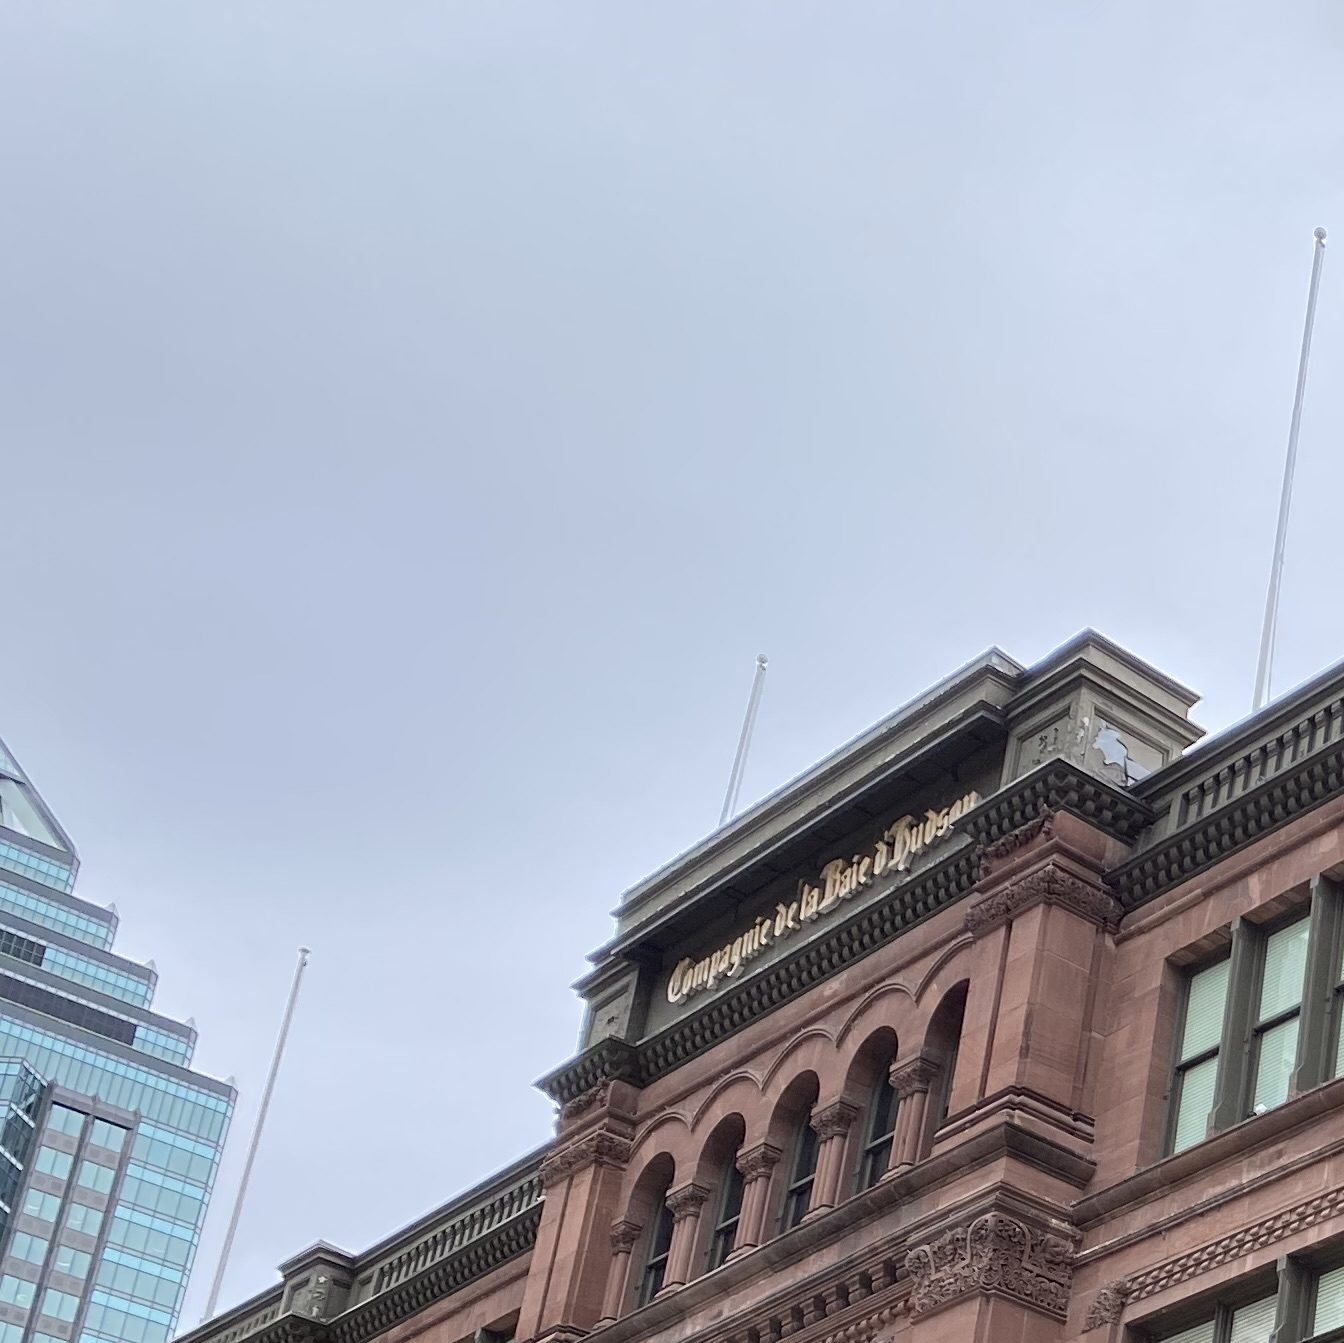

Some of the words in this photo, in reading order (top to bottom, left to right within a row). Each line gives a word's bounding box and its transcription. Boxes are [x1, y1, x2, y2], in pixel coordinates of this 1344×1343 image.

[667, 916, 774, 1003] Compagnie
[774, 901, 800, 938] de
[800, 883, 821, 922] la
[817, 857, 872, 913] Baie
